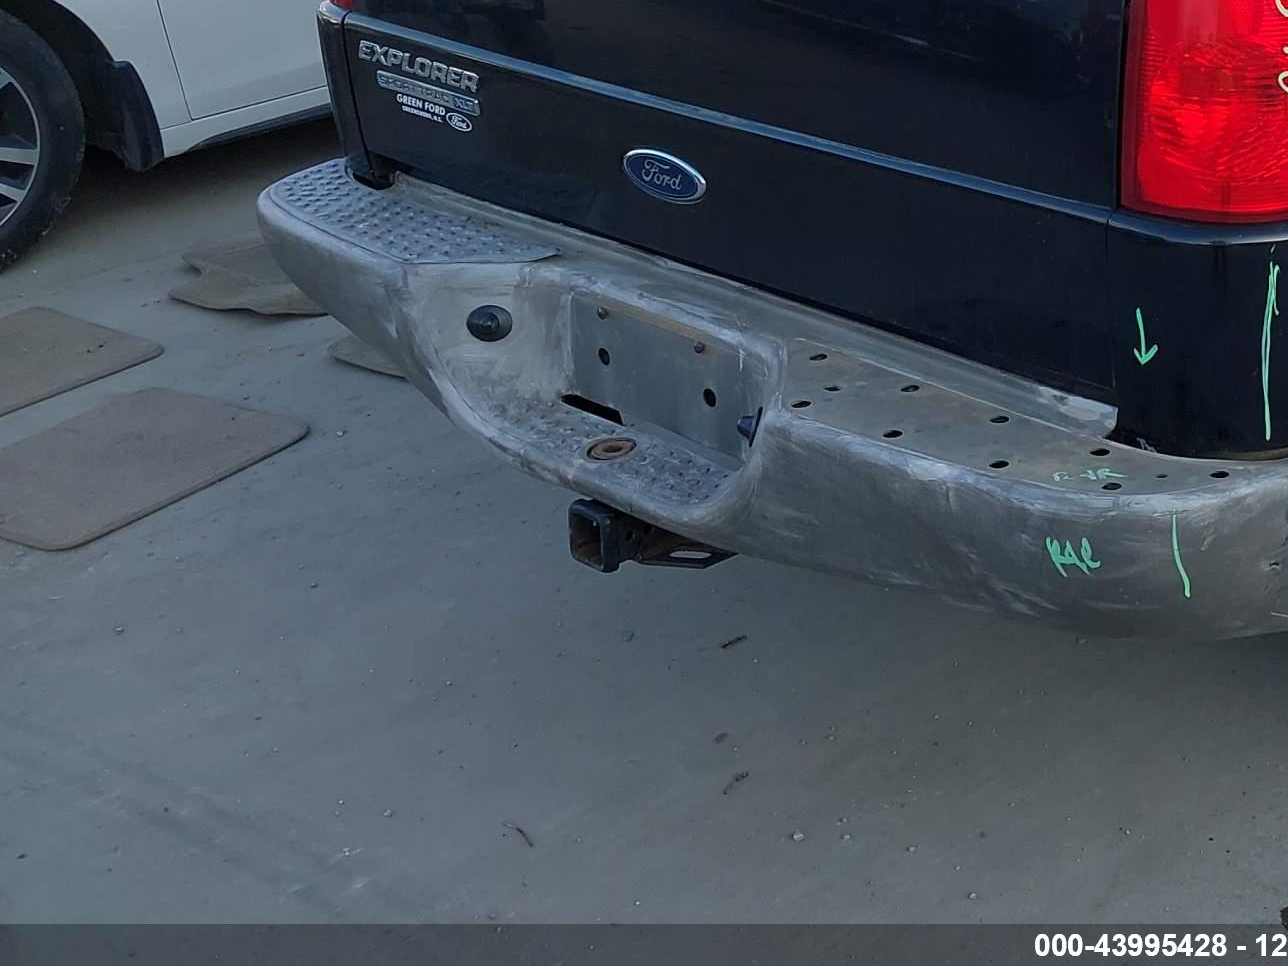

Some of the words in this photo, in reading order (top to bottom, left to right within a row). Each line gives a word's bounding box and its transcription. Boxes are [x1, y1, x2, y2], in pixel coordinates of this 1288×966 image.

[358, 39, 480, 93] EXPLORER
[396, 93, 422, 110] GREEN
[424, 101, 446, 116] FORD
[641, 159, 682, 191] Ford
